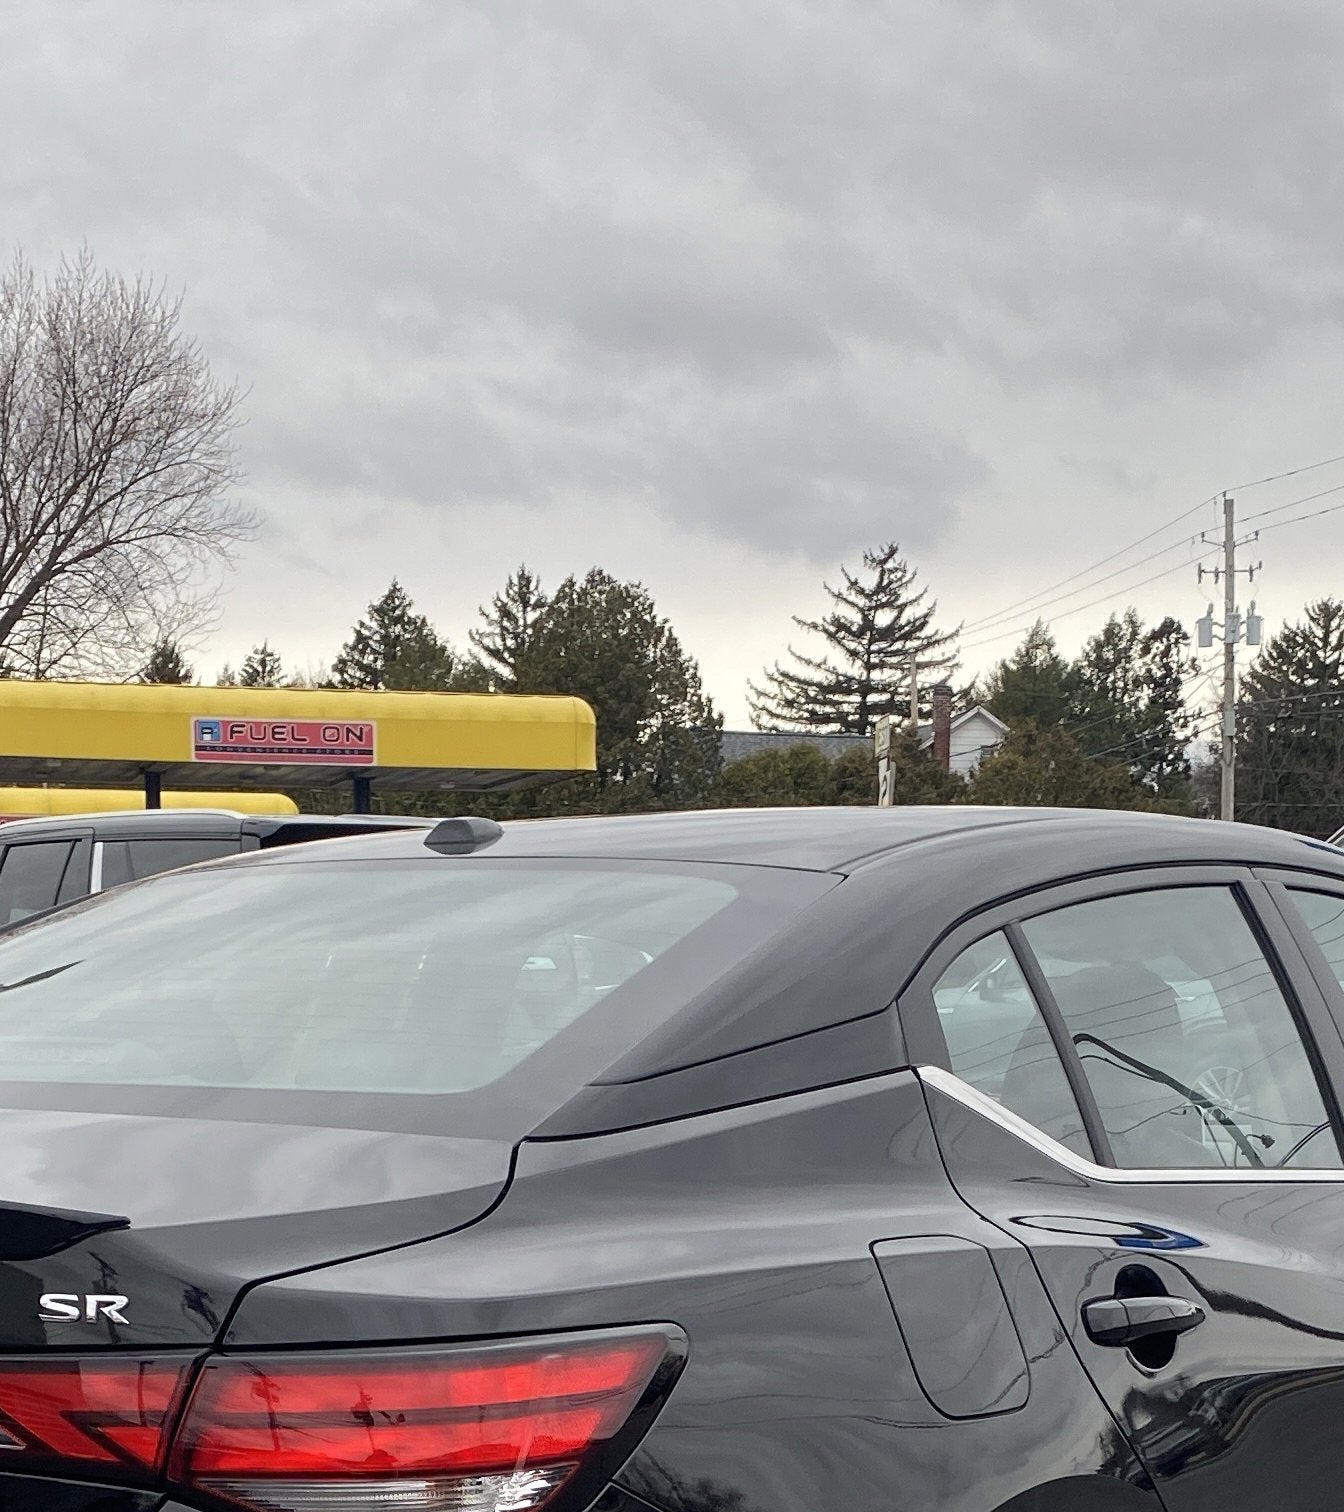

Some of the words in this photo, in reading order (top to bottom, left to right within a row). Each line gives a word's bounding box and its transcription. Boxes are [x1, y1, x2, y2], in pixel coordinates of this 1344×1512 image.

[229, 723, 309, 743] FUEL
[322, 725, 365, 744] ON
[38, 1293, 130, 1325] SR
